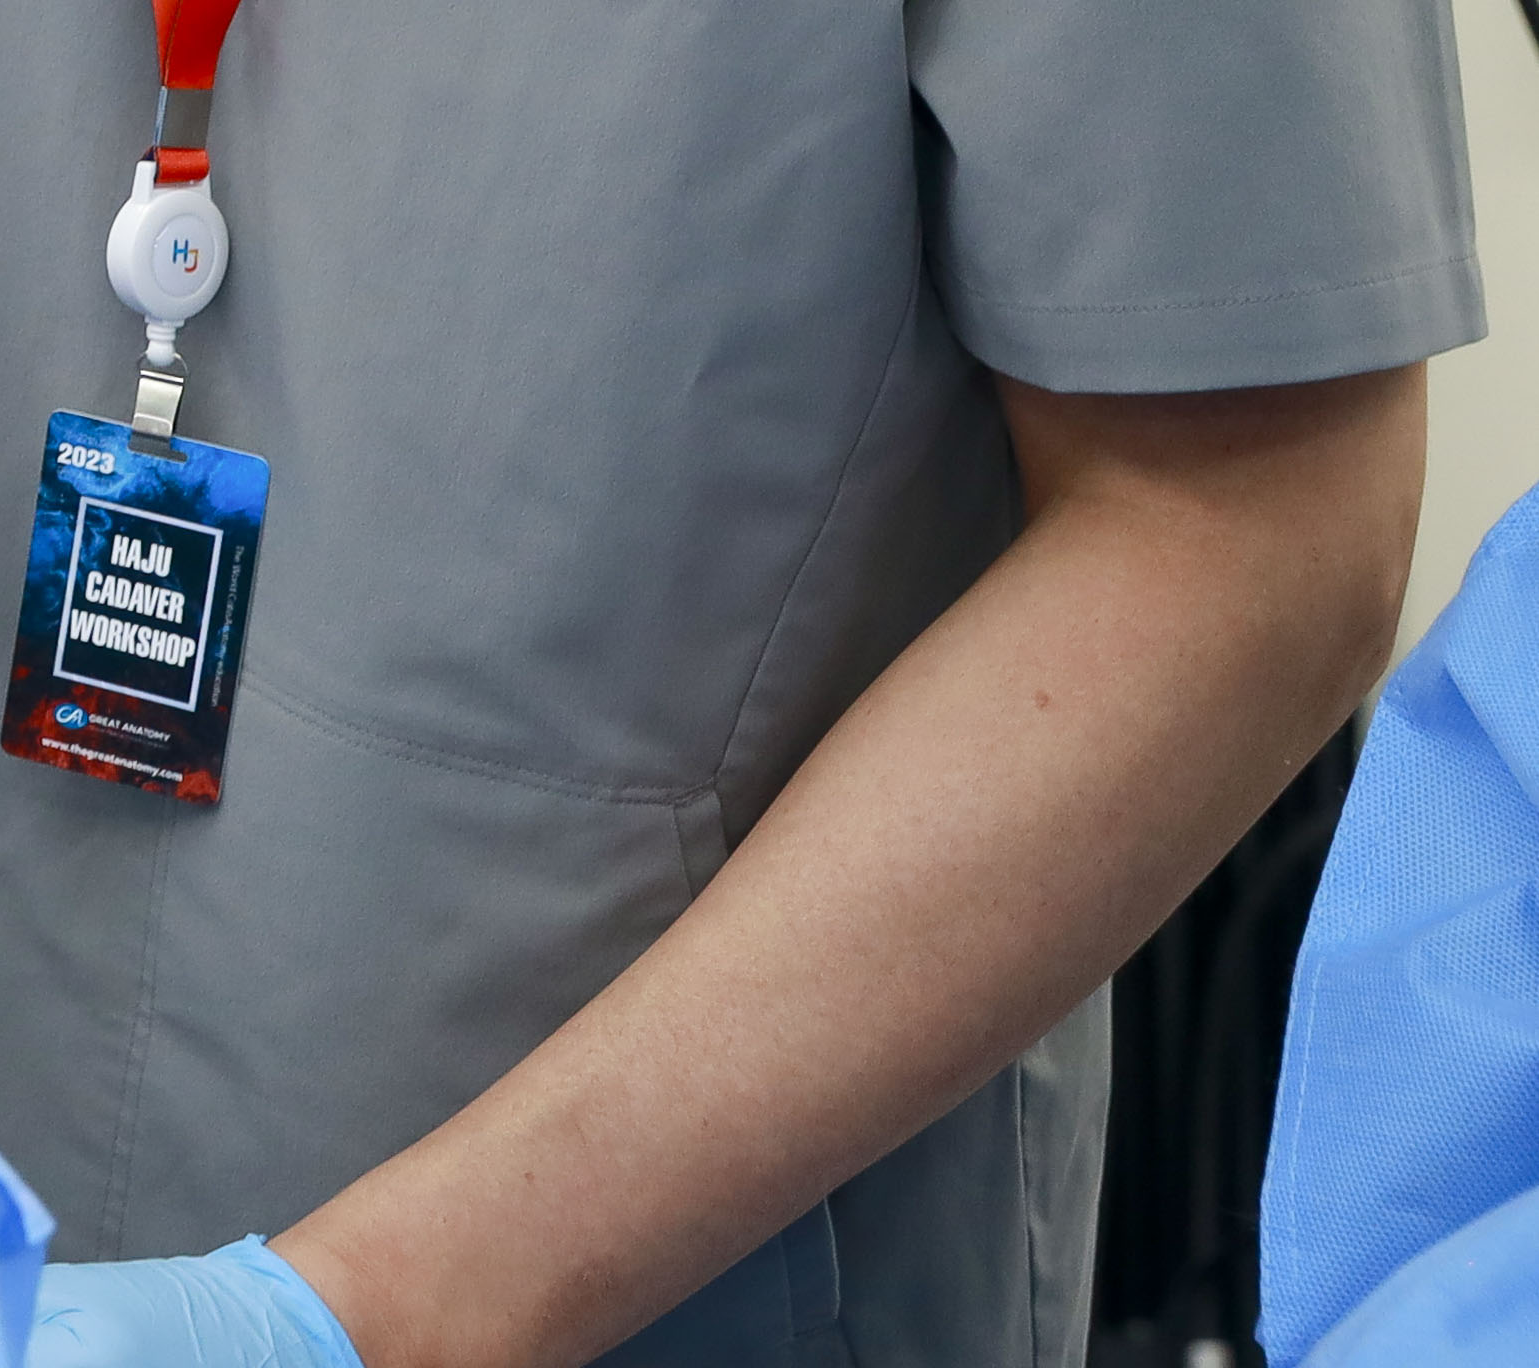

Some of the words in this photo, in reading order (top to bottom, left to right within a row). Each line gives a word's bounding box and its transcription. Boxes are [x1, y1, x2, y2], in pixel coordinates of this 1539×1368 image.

[57, 443, 115, 474] 2023
[110, 533, 173, 579] HAJU
[84, 570, 186, 625] CADAVER
[70, 608, 197, 669] WORKSHOP
[41, 736, 184, 783] www.thegreatanatomy.com
